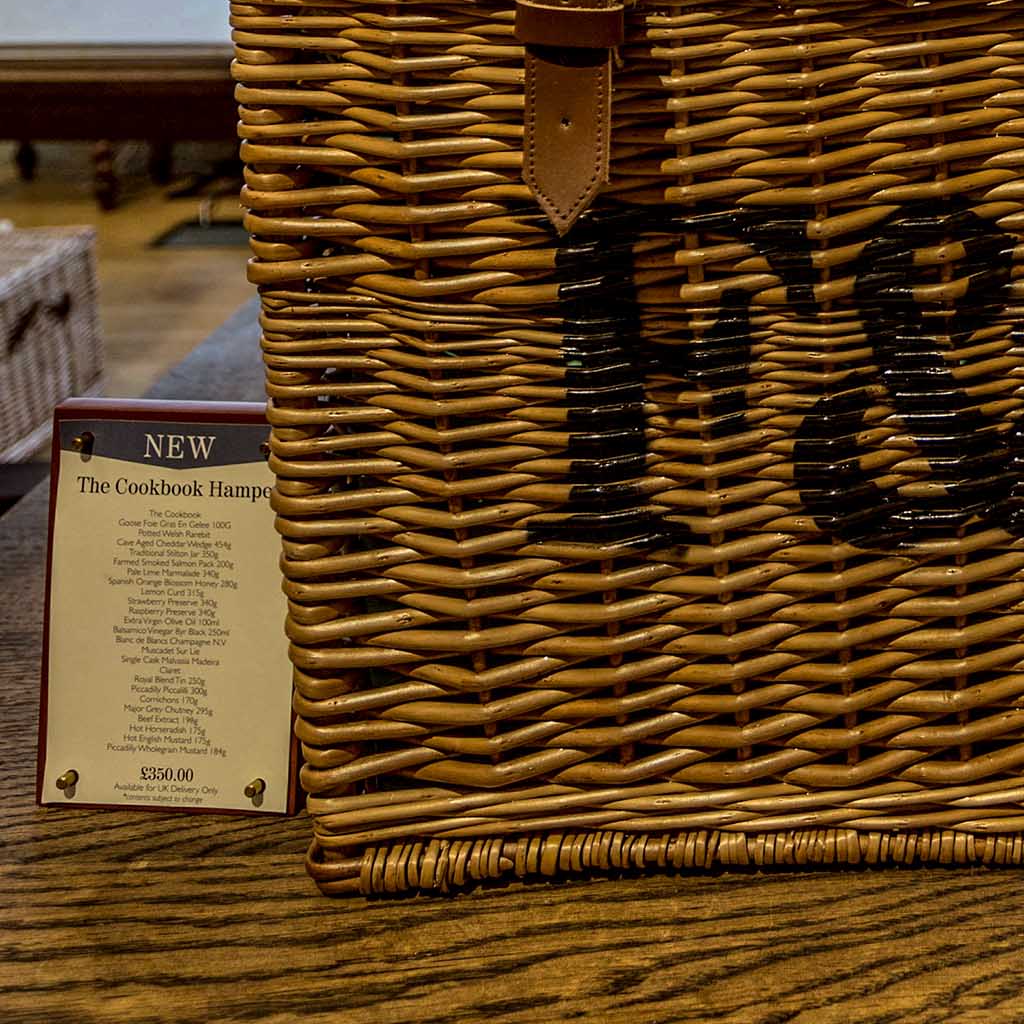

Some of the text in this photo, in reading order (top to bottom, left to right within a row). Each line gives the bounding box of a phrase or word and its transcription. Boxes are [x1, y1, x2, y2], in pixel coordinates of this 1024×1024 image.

[143, 433, 216, 460] NEW
[77, 476, 272, 502] The Cookbook Hampe
[149, 509, 201, 518] The Cookbook
[142, 558, 169, 567] Smoked
[140, 695, 180, 704] Cornichons
[129, 724, 144, 732] Hot
[140, 766, 194, 782] £350.00
